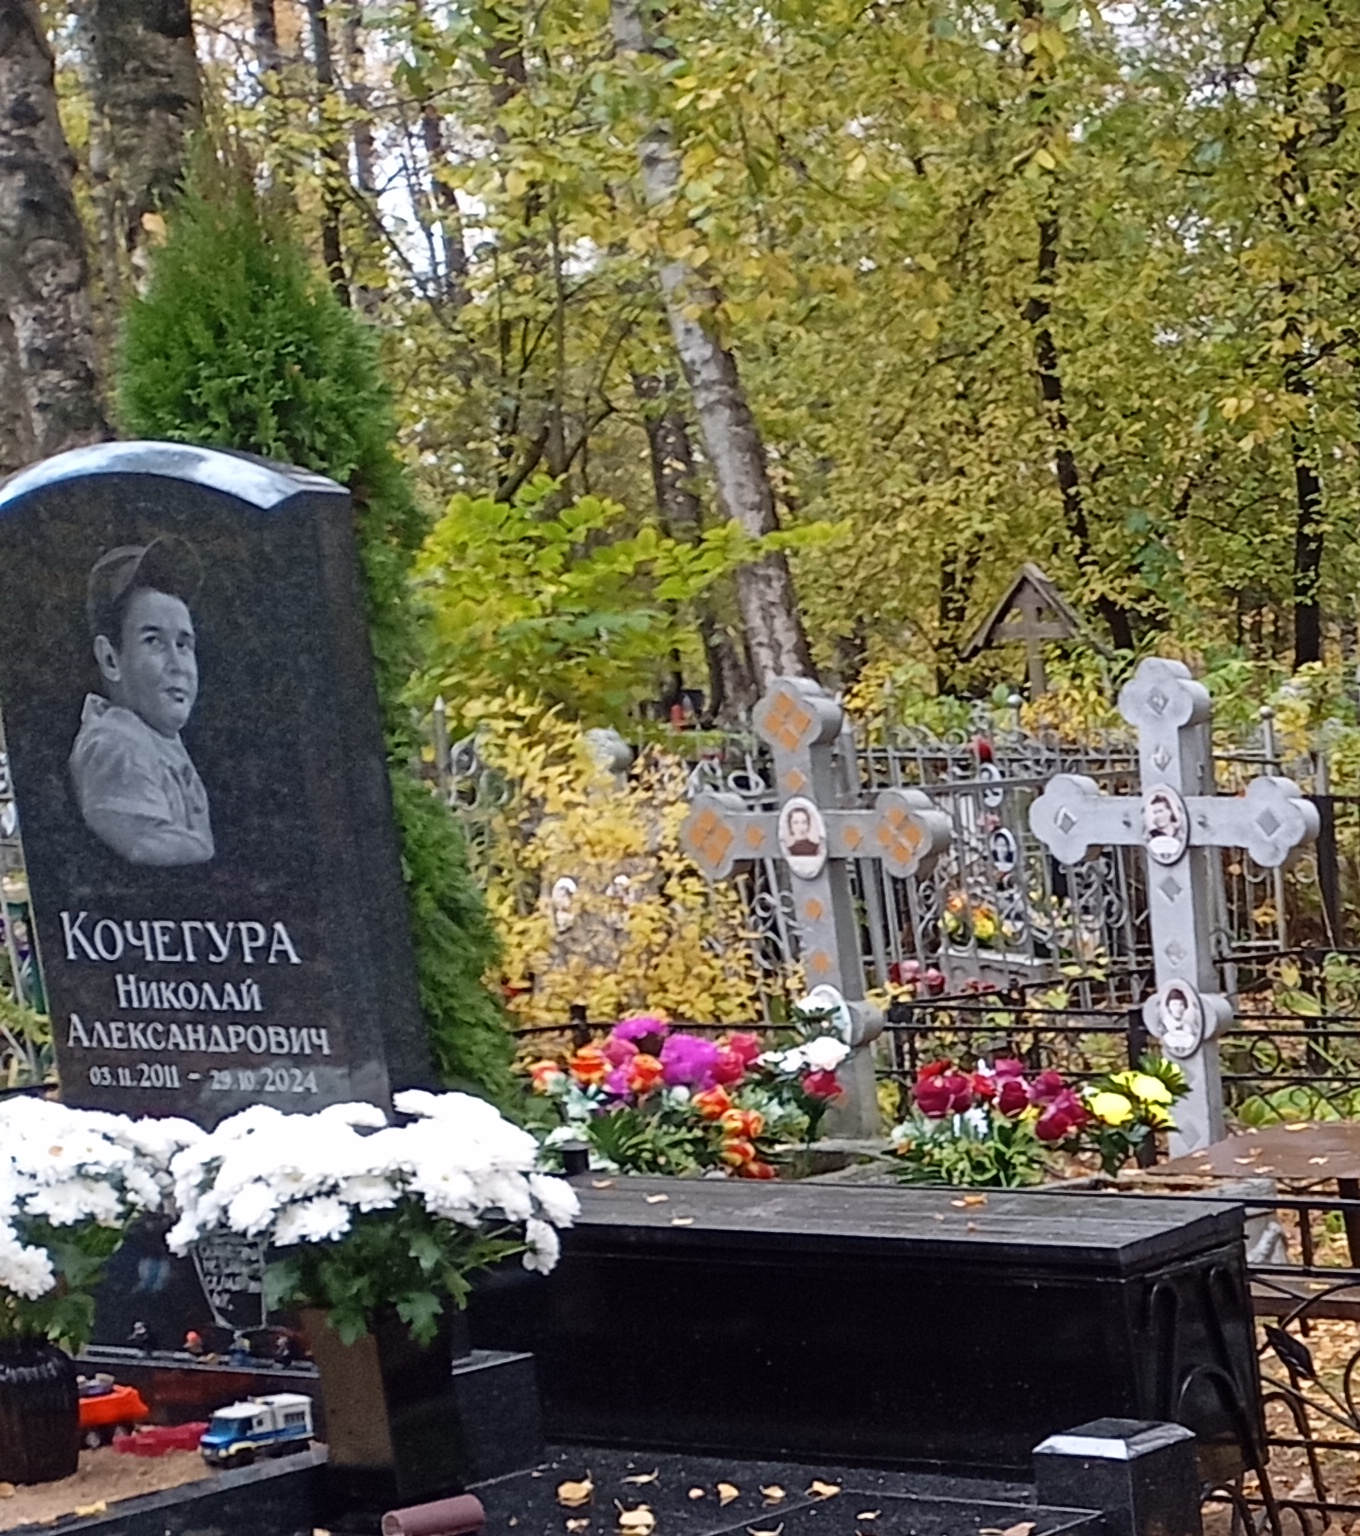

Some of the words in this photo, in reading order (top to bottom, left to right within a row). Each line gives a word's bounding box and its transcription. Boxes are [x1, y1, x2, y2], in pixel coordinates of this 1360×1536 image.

[59, 910, 302, 964] КОЧЕГУРА
[114, 973, 264, 1011] НИКОЛАЙ
[67, 1012, 332, 1055] АЛЕКСАНДРОВИЧ
[89, 1062, 181, 1089] 03.11.2011
[210, 1066, 318, 1094] 29.10.2024
